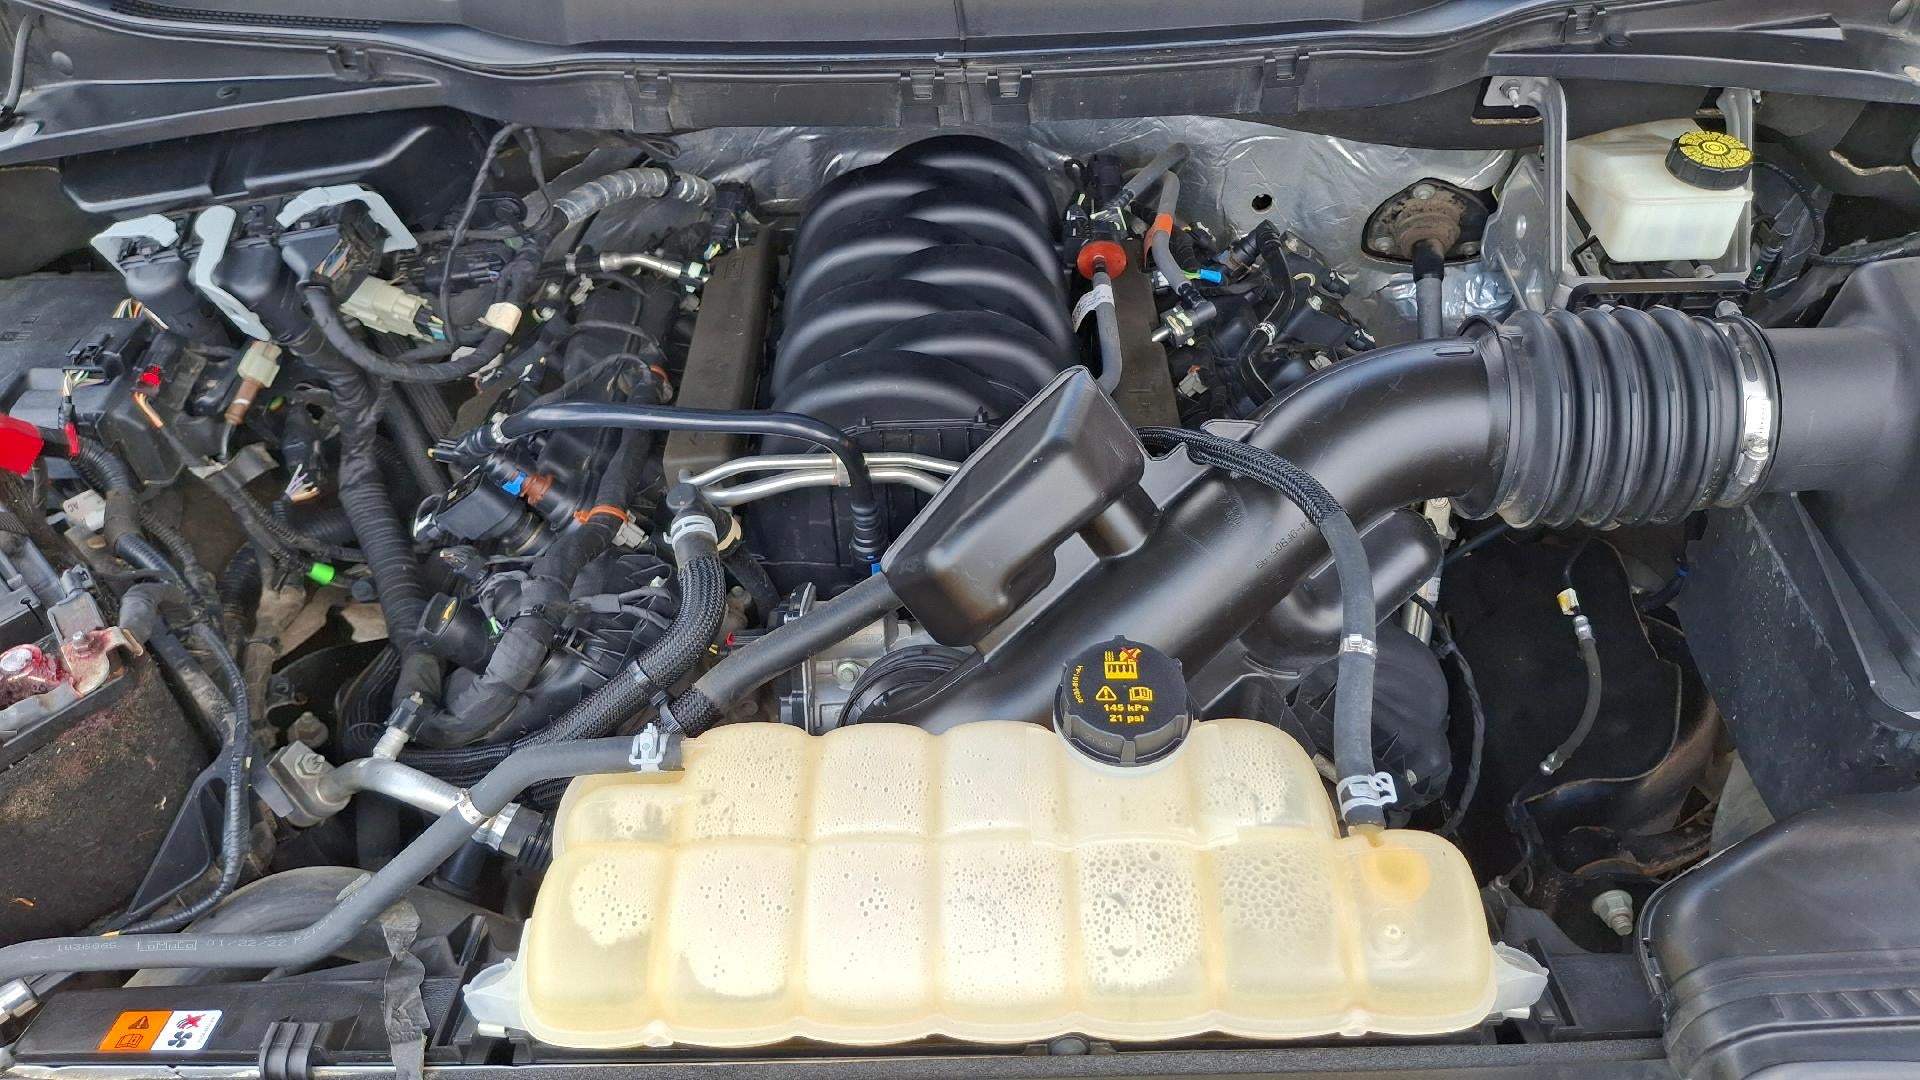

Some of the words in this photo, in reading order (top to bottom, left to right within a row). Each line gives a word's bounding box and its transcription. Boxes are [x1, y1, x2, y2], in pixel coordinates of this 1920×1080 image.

[1103, 703, 1125, 712] 145
[1127, 703, 1150, 712] kPa
[1109, 714, 1123, 723] 21
[1127, 714, 1145, 724] psi
